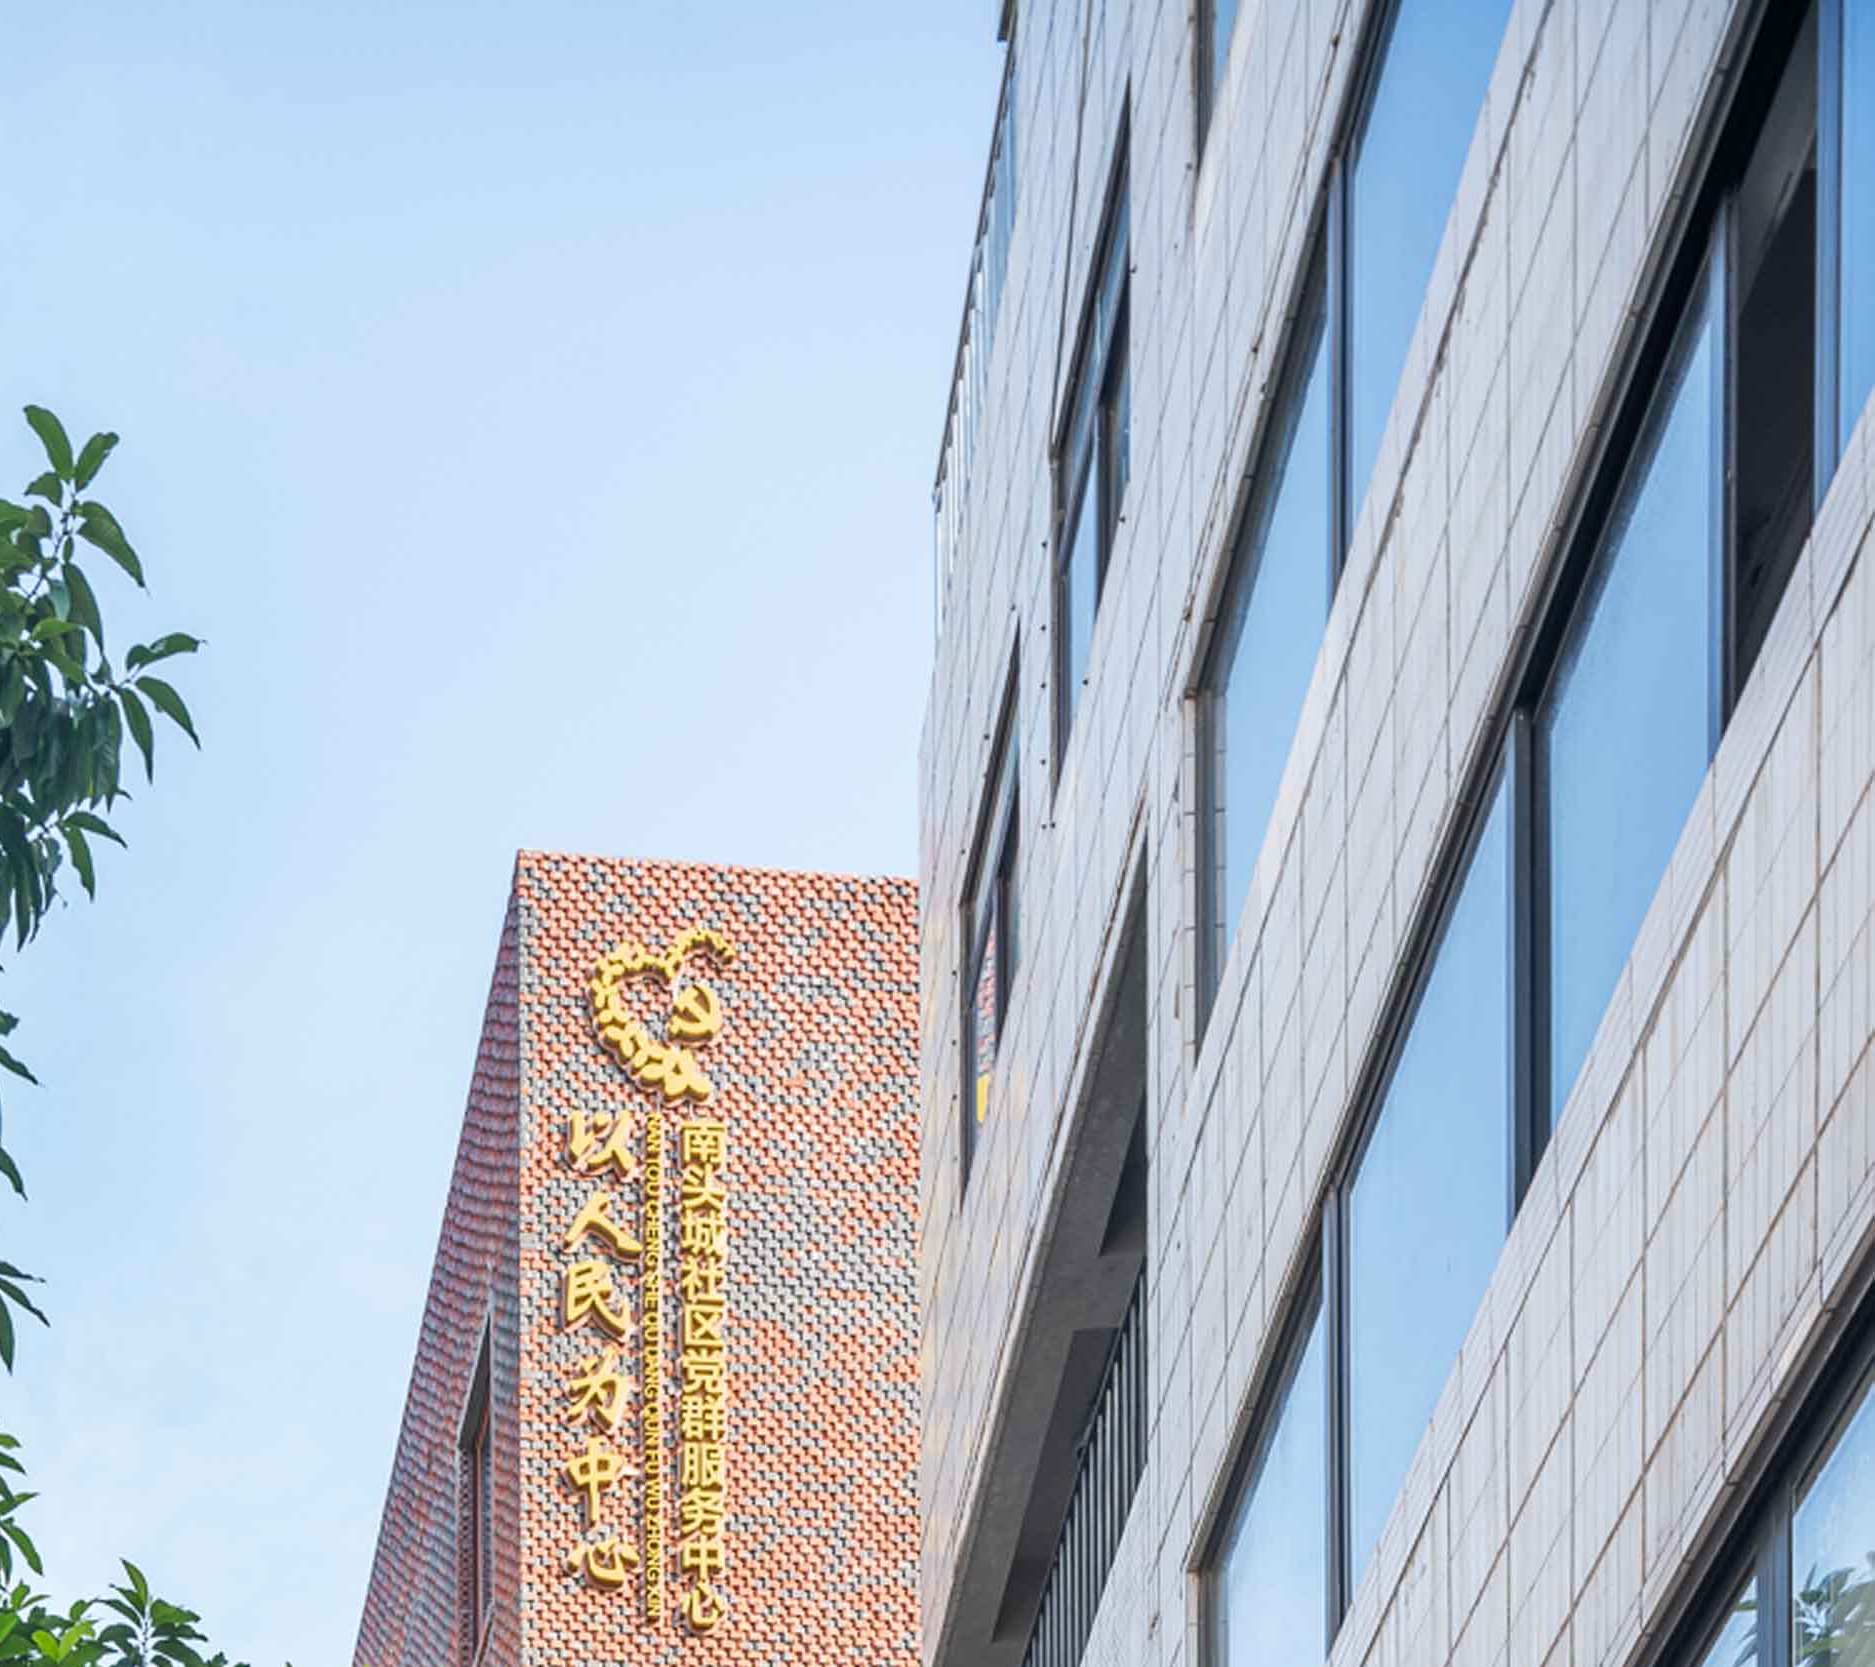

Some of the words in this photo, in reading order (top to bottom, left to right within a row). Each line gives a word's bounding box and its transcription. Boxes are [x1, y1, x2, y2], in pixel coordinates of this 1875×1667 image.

[645, 1158, 661, 1197] TOU
[645, 1199, 661, 1267] CHENG
[645, 1271, 661, 1309] SHE
[645, 1312, 661, 1342] QU
[563, 1109, 644, 1590] 以人民为中心
[645, 1346, 661, 1398] DANG
[681, 1117, 726, 1632] 南头城社区党群服务中心
[645, 1402, 661, 1446] QUN
[645, 1449, 661, 1473] FU
[645, 1478, 661, 1509] WU
[645, 1513, 661, 1580] ZHONG
[645, 1584, 661, 1617] XIN
